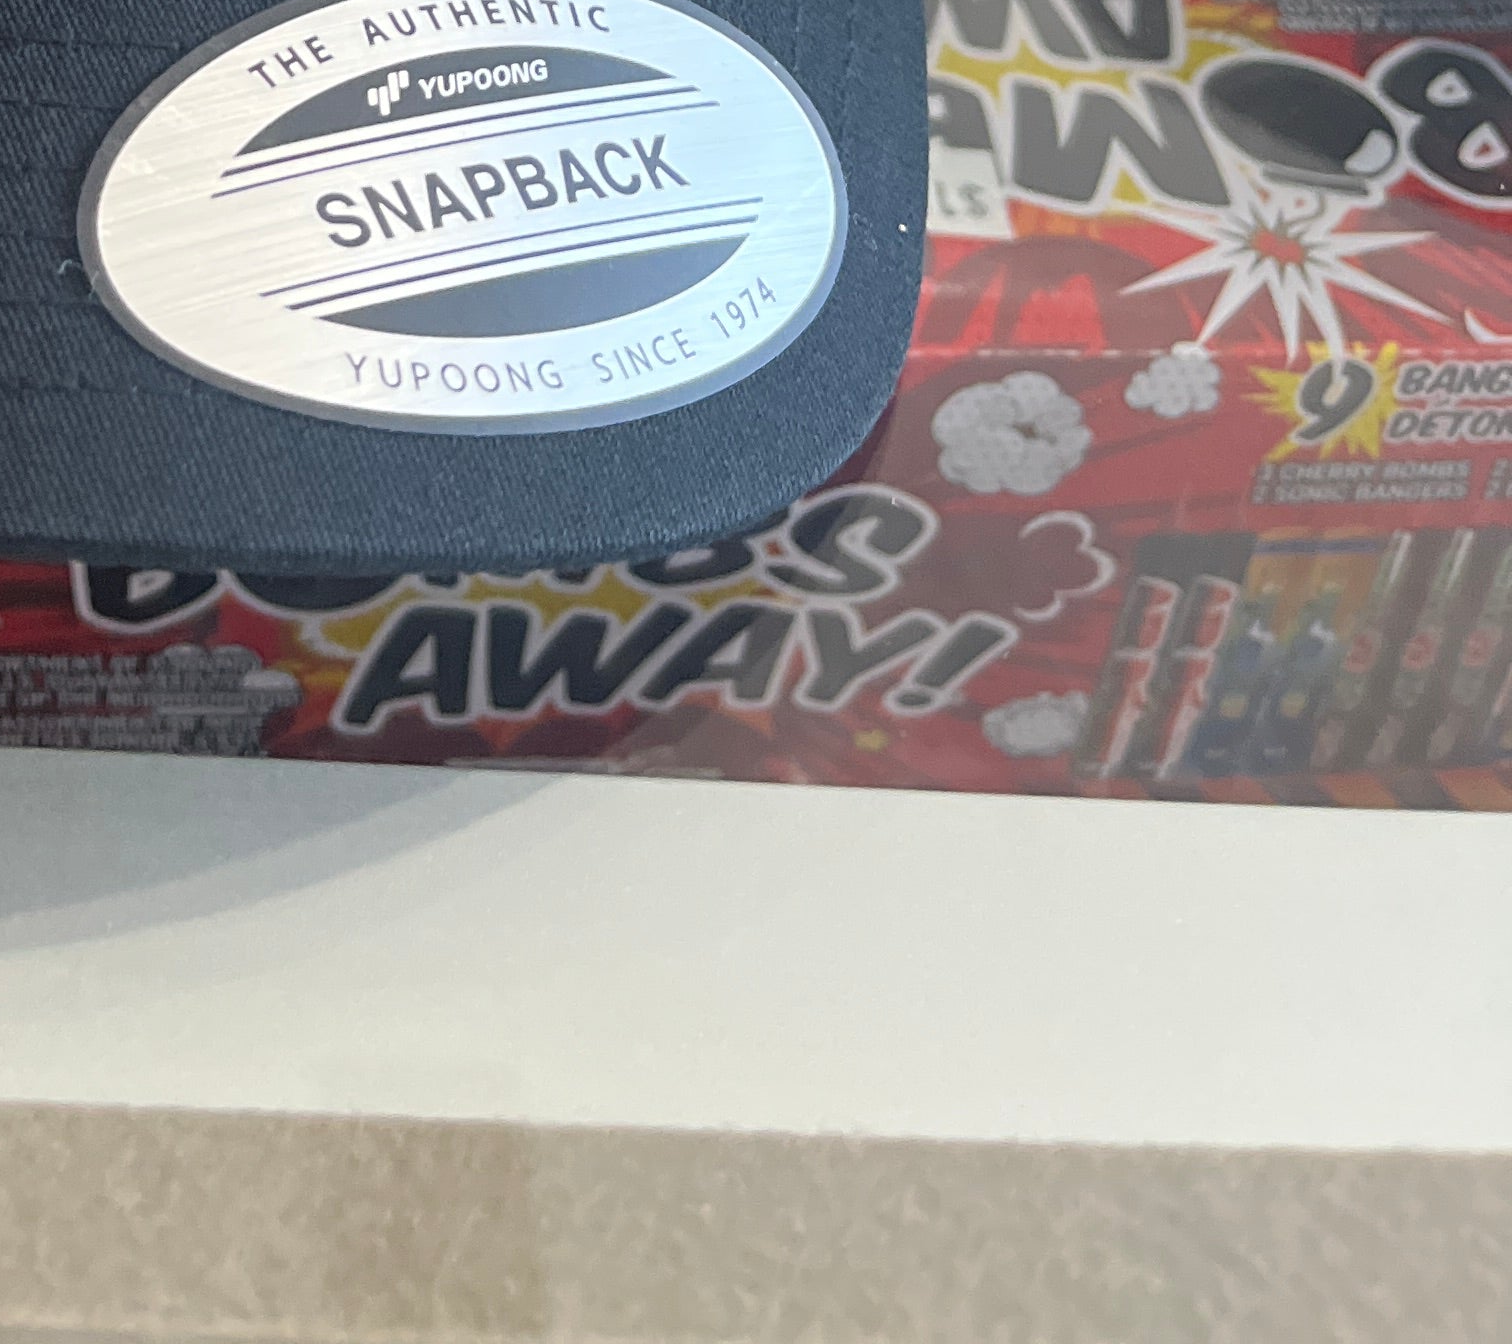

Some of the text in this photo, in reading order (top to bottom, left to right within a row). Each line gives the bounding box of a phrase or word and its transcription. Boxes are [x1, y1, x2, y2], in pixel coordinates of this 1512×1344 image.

[248, 35, 335, 89] THE
[418, 58, 549, 100] YUPOONG
[316, 134, 691, 248] SNAPBACK
[344, 276, 777, 394] YUPOONG SINCE 1974
[1294, 357, 1376, 442] 9
[338, 602, 1014, 729] AWAY!
